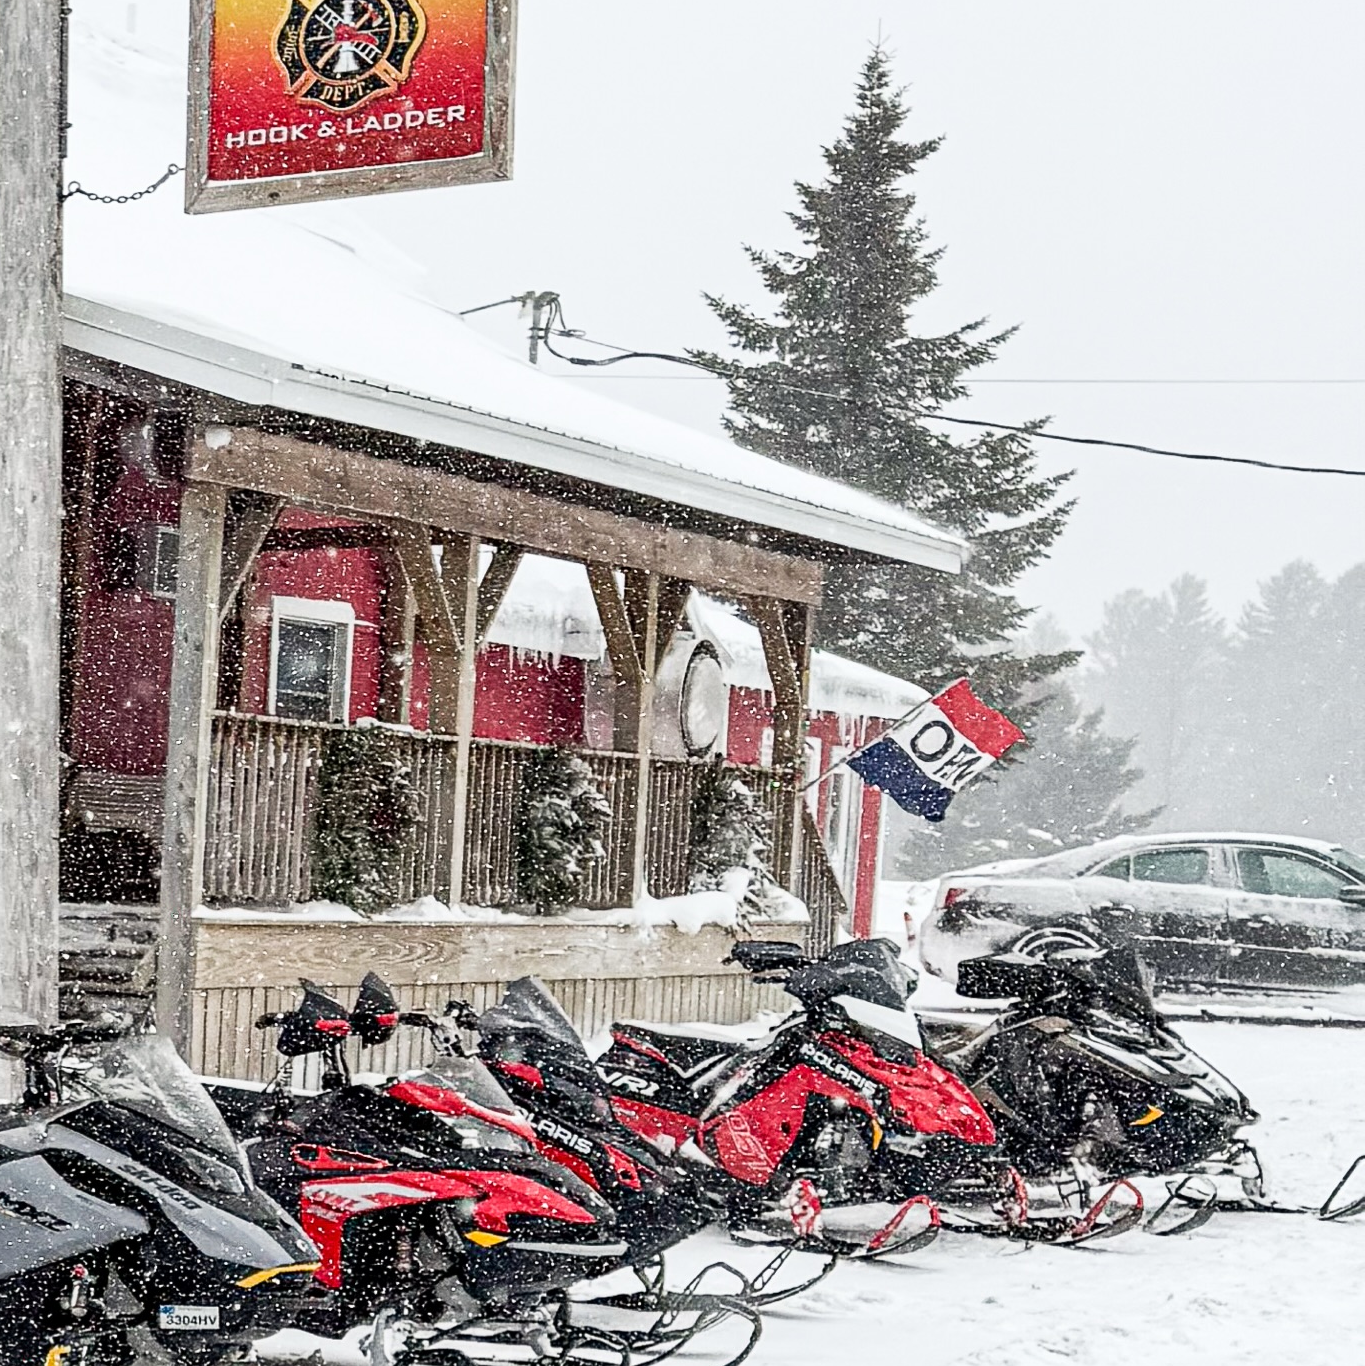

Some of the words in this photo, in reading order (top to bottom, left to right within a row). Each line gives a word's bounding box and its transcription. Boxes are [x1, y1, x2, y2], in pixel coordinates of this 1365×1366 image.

[226, 123, 313, 149] HOOK
[317, 119, 337, 138] &
[346, 104, 467, 135] LADDER
[165, 1315, 218, 1326] 3304HV
